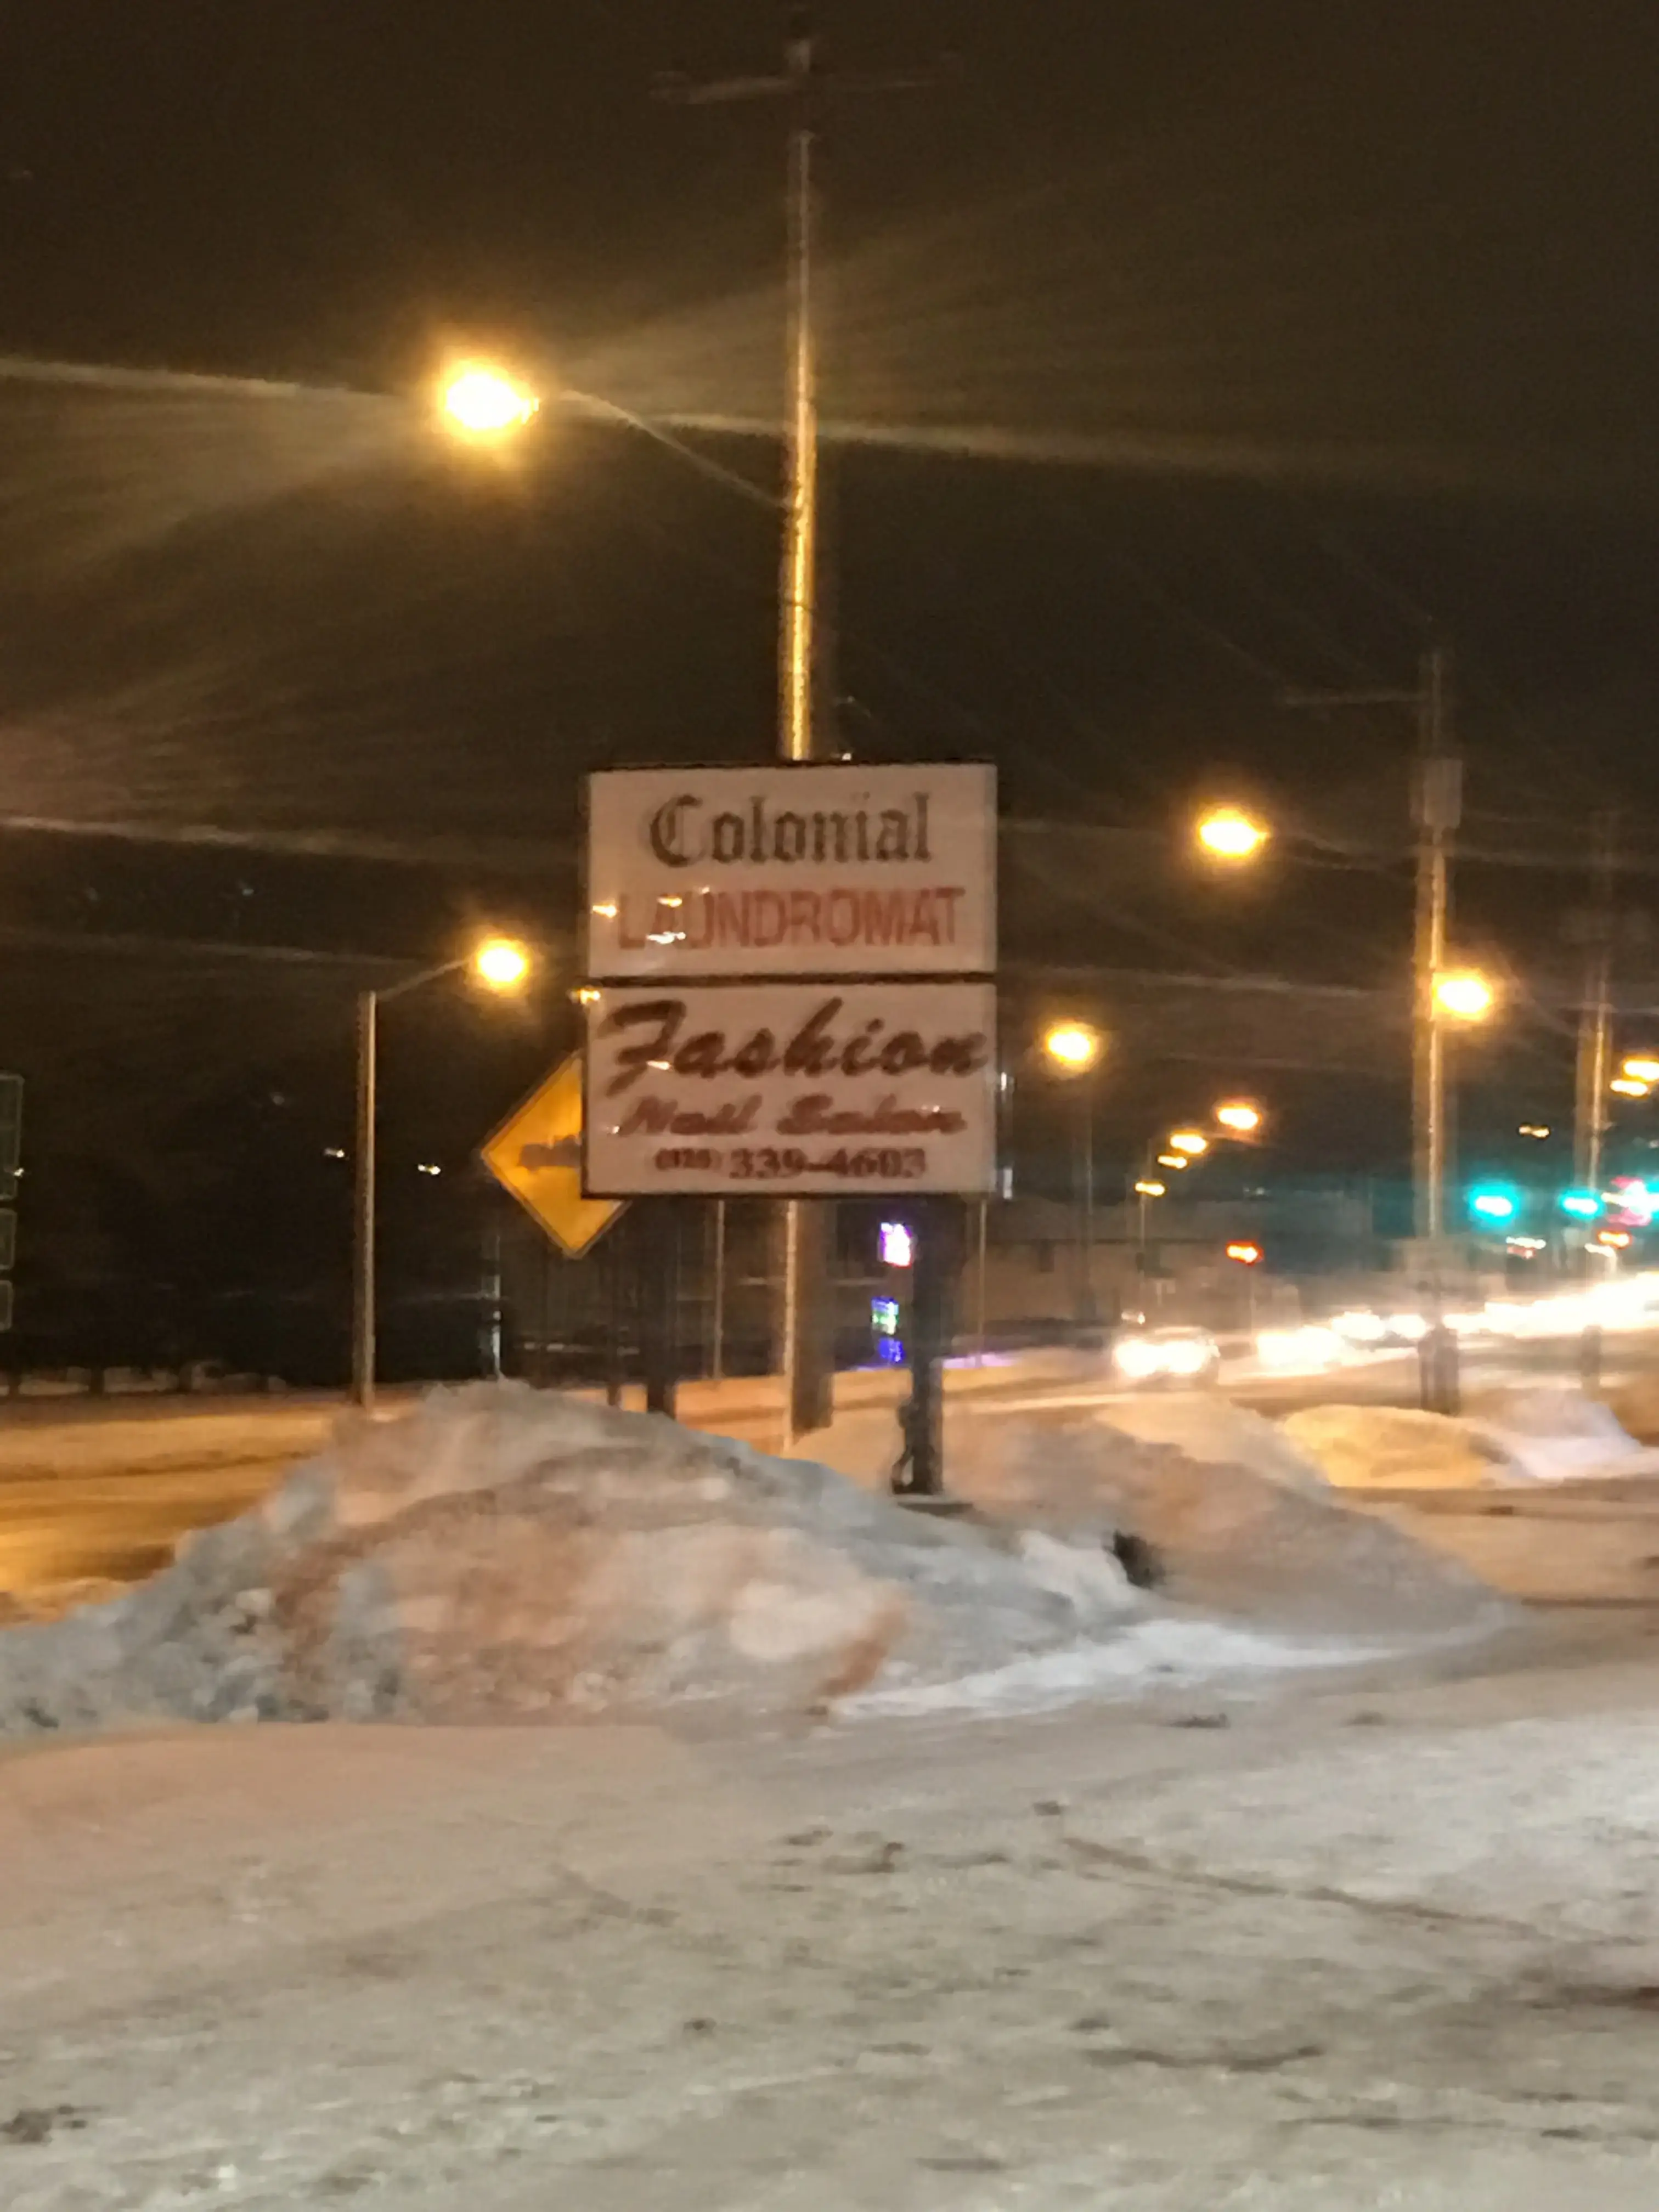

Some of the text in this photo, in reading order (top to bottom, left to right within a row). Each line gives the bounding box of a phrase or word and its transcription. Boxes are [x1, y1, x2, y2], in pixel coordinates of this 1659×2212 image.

[650, 792, 932, 868] Colonial
[618, 886, 966, 950] LAUNDROMAT
[599, 996, 986, 1096] Fashion
